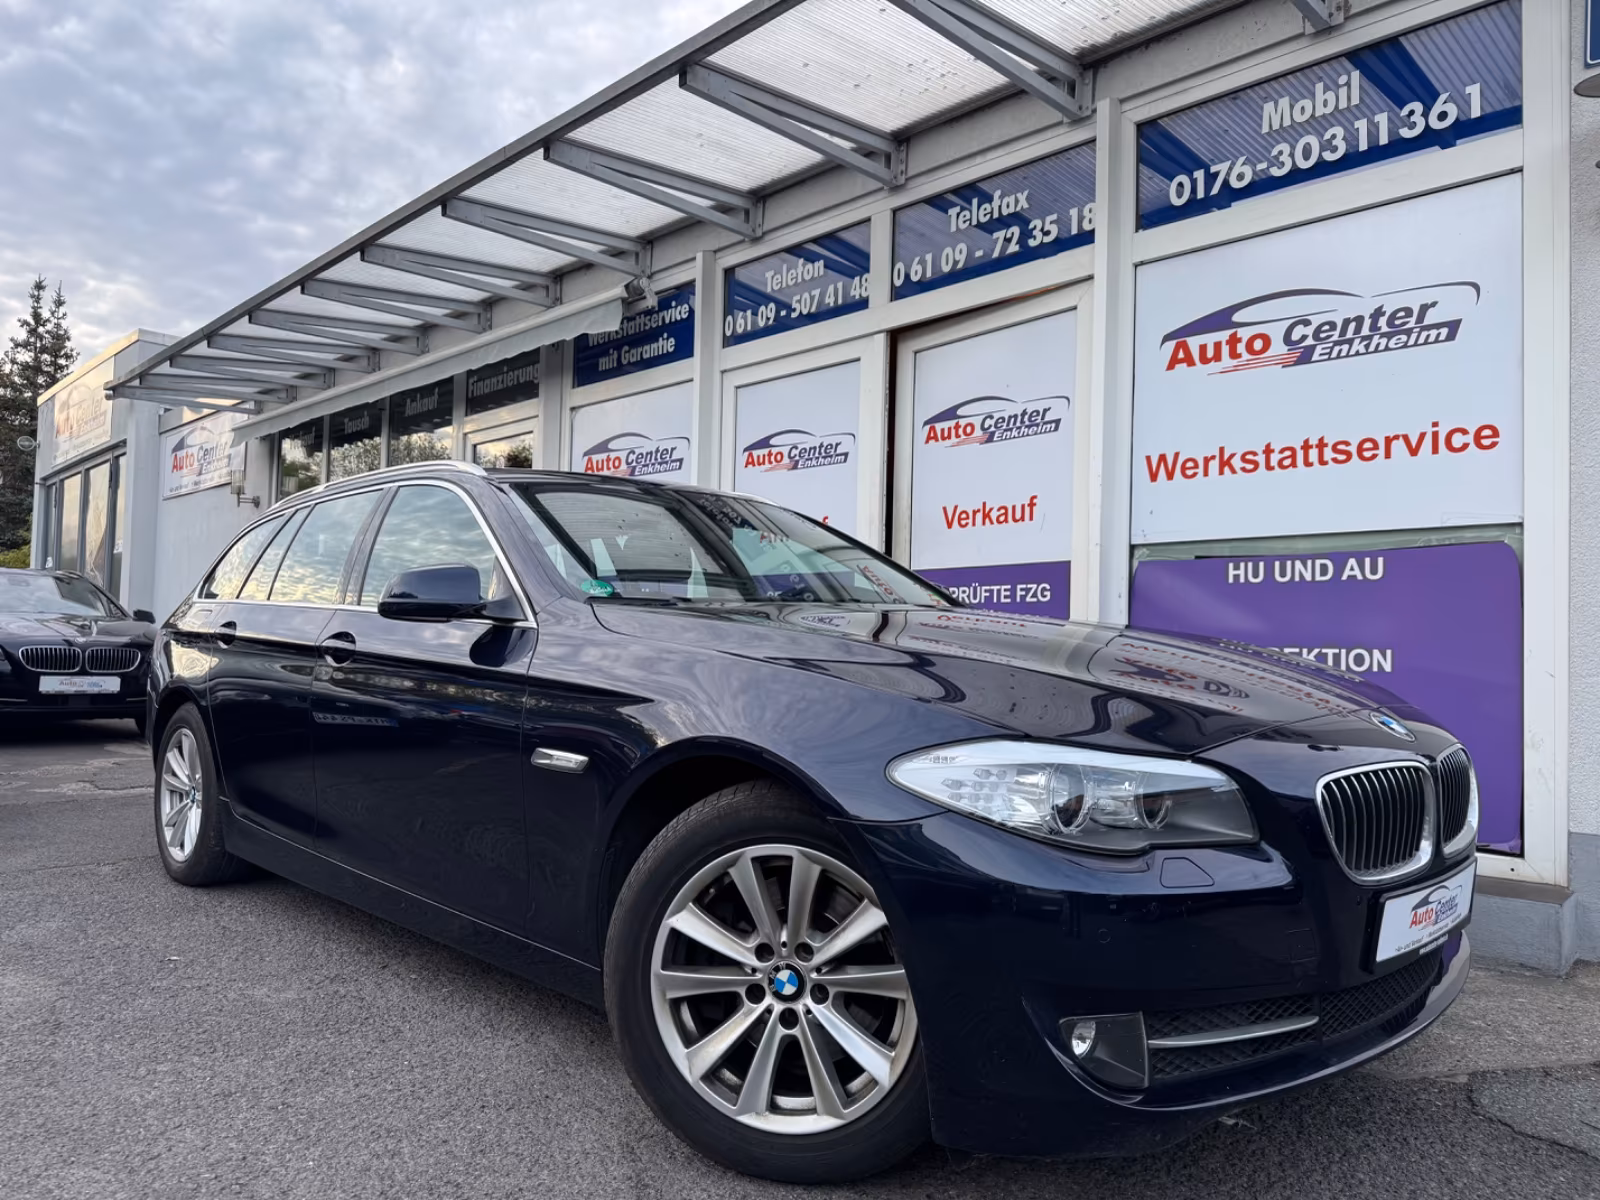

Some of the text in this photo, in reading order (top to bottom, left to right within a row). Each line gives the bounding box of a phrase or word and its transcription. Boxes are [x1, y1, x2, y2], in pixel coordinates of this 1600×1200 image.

[1261, 70, 1361, 134] Mobil
[948, 189, 1030, 233] Telefax
[941, 243, 968, 273] 09
[991, 226, 1020, 259] 72
[1027, 213, 1058, 247] 35
[1069, 203, 1096, 235] 18
[765, 258, 824, 293] Telefon
[758, 302, 776, 327] 09
[791, 288, 821, 318] 507
[825, 281, 843, 307] 41
[850, 273, 870, 300] 48
[598, 333, 675, 371] mit Garantie
[1165, 300, 1438, 372] Auto Center
[1310, 325, 1450, 362] Enkheim
[468, 363, 540, 398] Finanzierung
[405, 387, 439, 417] Ankauf
[344, 410, 370, 435] Tausch
[924, 406, 1052, 445] Auto Center
[993, 421, 1056, 442] Enkheim
[171, 450, 195, 473] Auto
[584, 445, 677, 473] Auto Center
[634, 460, 680, 475] Enkheim
[744, 441, 842, 468] Auto Center
[797, 456, 845, 469] Enkheim
[1145, 420, 1501, 483] Werkstattservice
[942, 494, 1038, 530] Verkauf
[1228, 557, 1385, 583] HU UND AU
[1016, 583, 1051, 603] FZG
[1409, 907, 1434, 929] Auto
